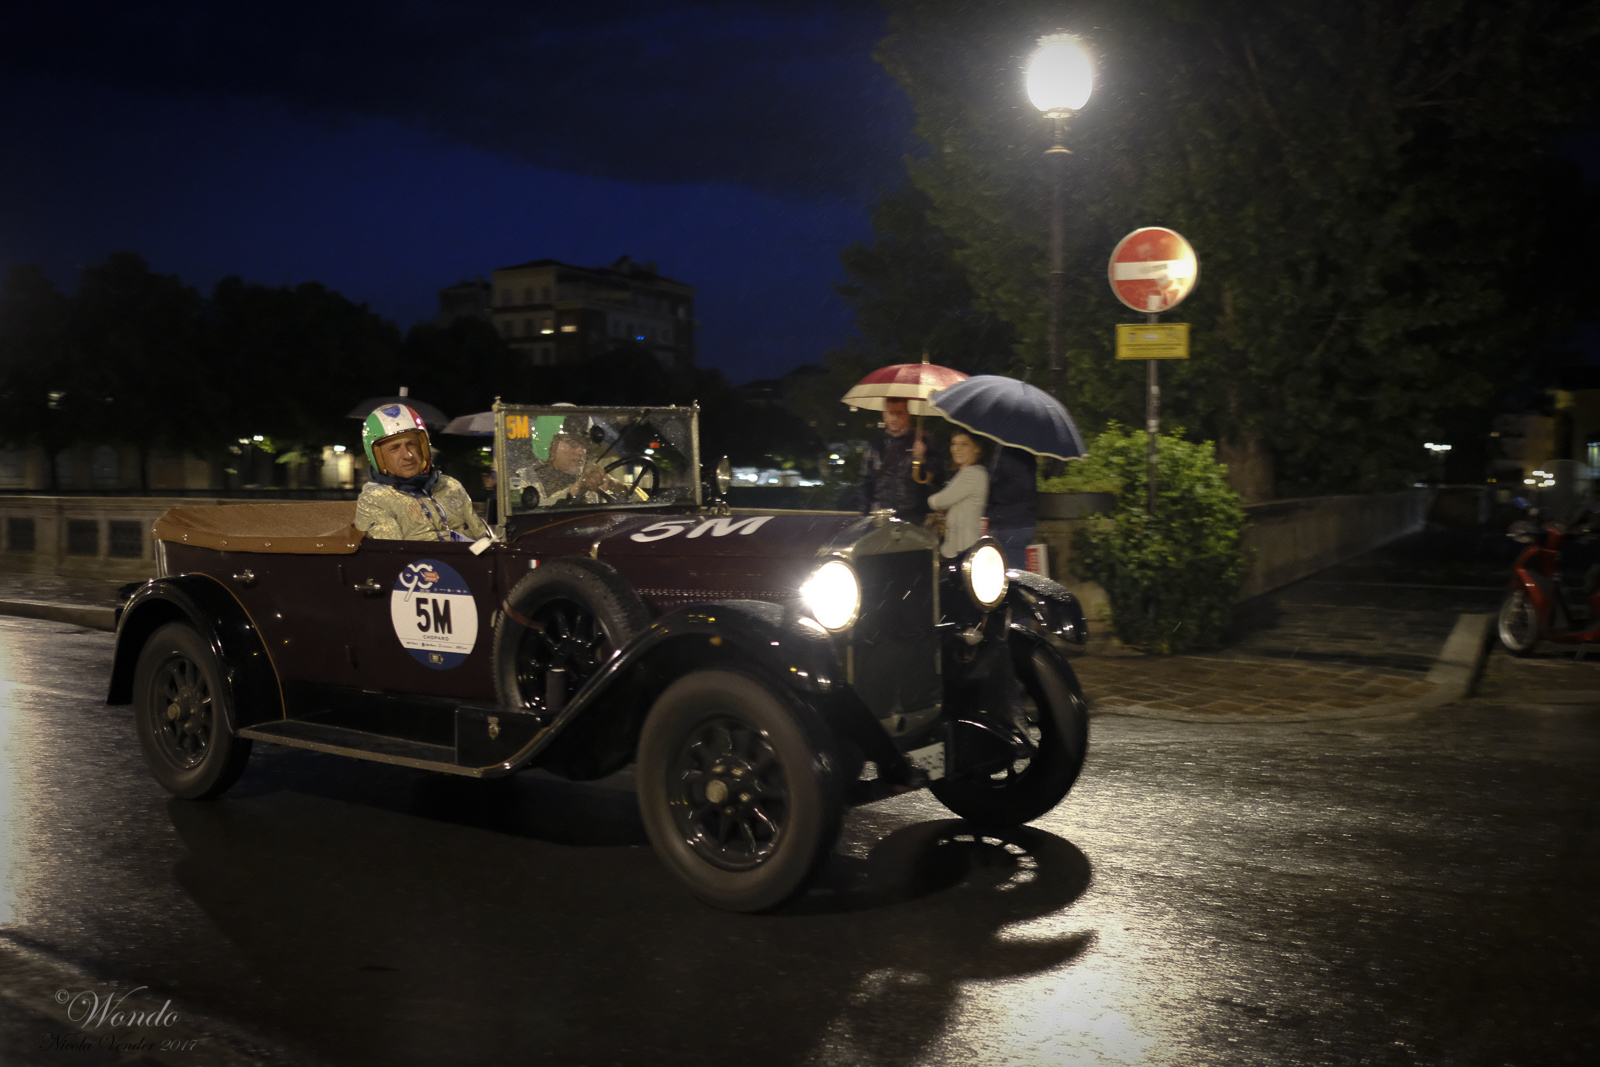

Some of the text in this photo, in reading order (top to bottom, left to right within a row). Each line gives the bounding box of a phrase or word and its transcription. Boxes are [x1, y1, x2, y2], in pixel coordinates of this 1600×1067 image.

[506, 415, 530, 440] 5M
[630, 516, 776, 543] 5M
[416, 597, 453, 635] 5M
